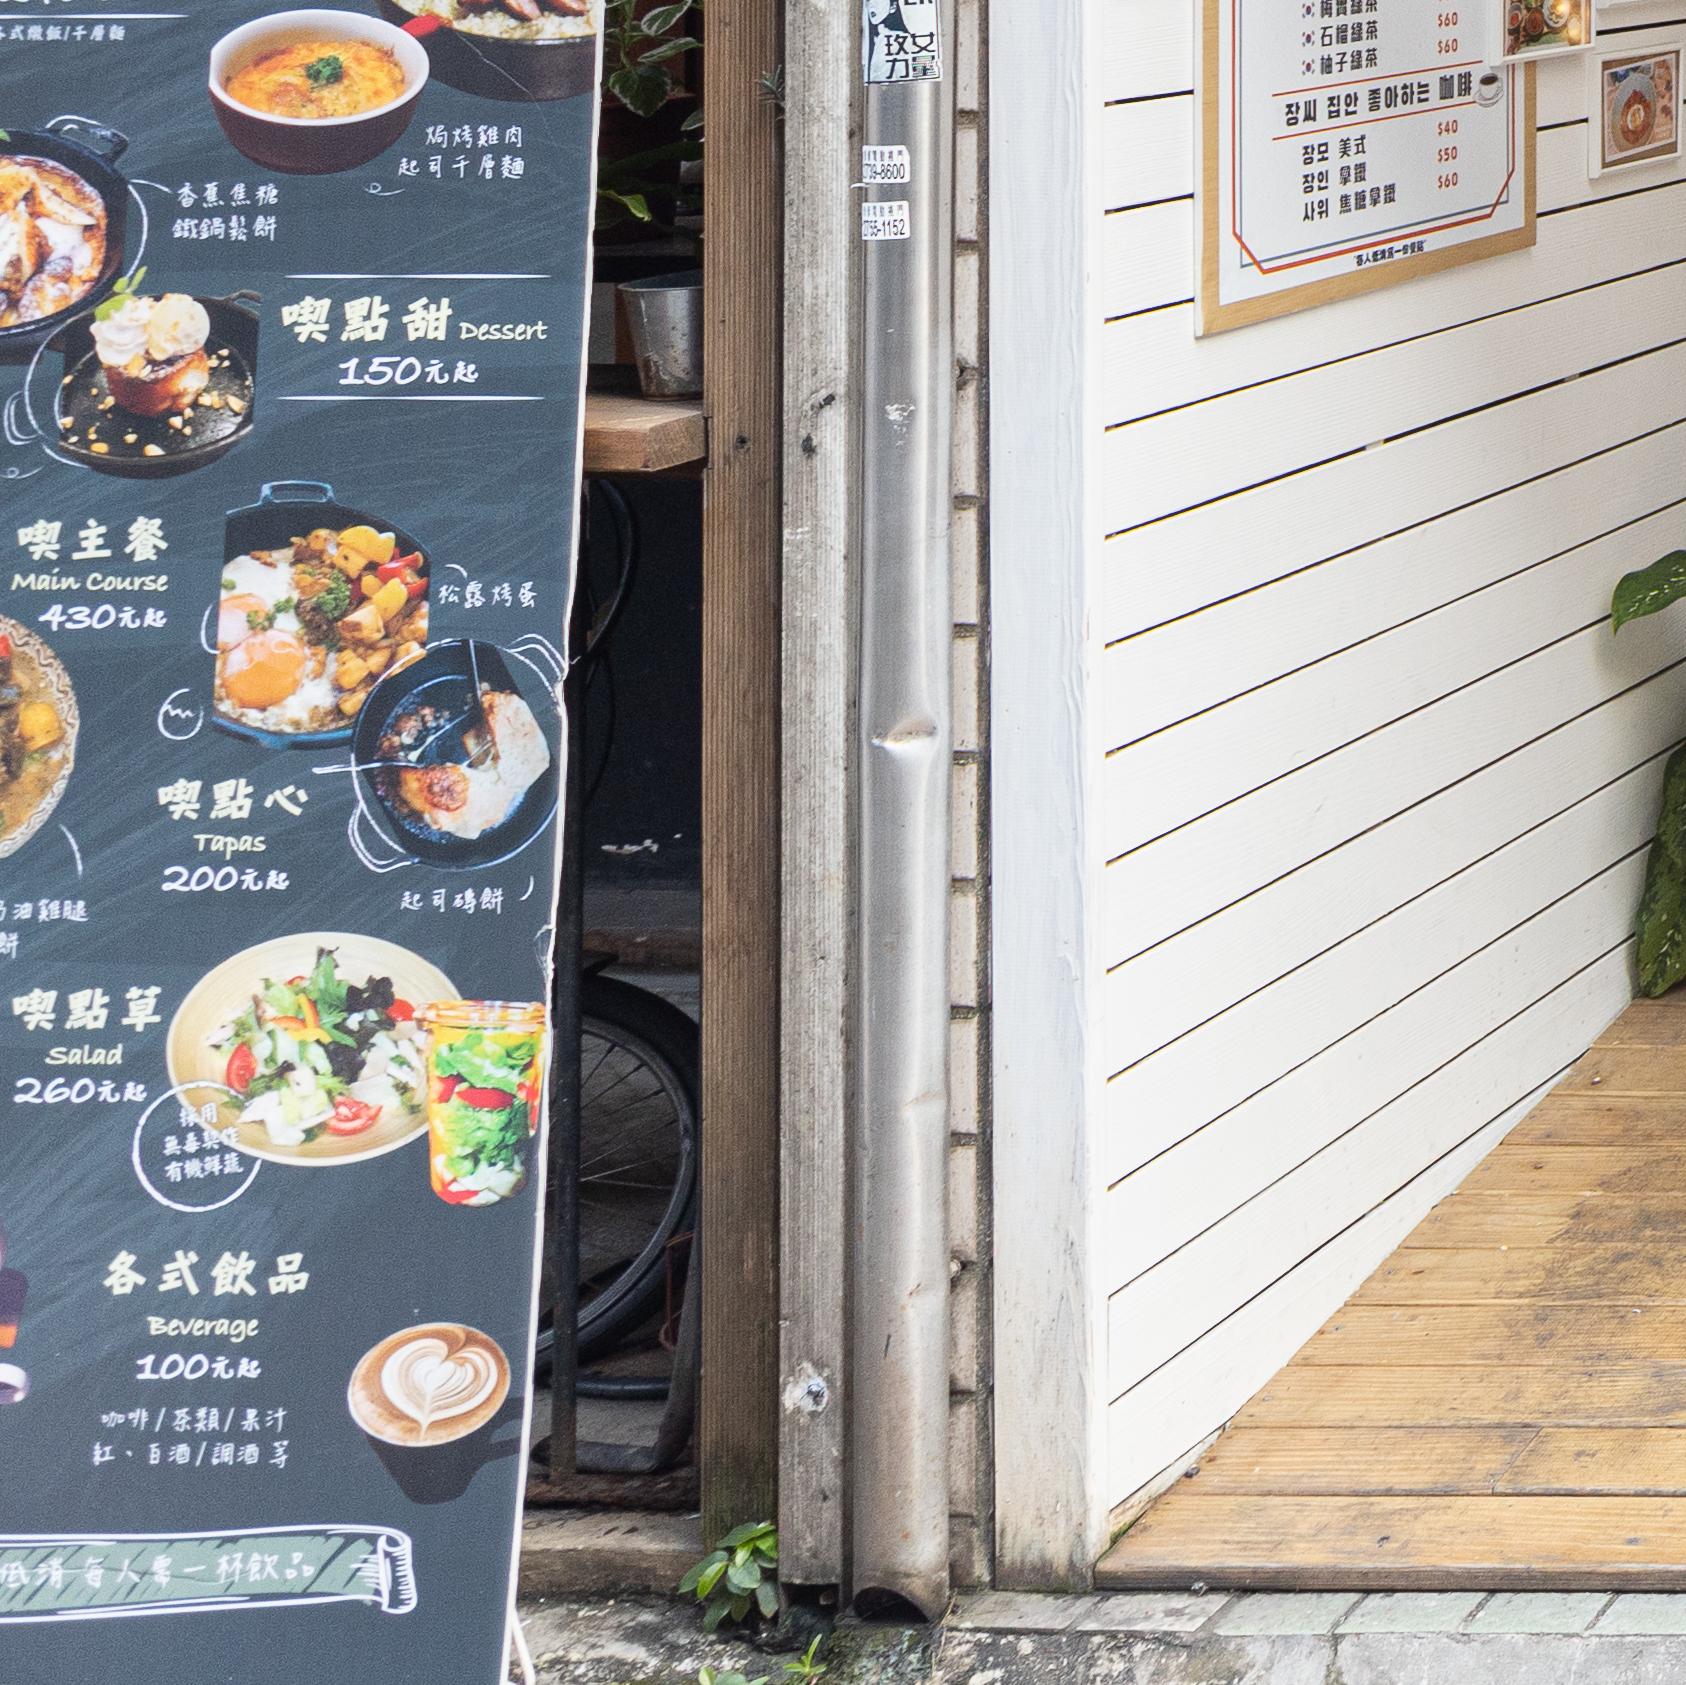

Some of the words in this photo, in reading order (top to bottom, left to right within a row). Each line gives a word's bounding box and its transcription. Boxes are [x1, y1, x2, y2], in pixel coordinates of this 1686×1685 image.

[1437, 12, 1458, 27] $60
[1437, 39, 1458, 54] $60
[1286, 99, 1317, 126] 장씨
[1328, 92, 1358, 119] 집안
[1368, 81, 1429, 112] 좋아하는
[425, 125, 523, 148] 焗烤雞肉
[1303, 142, 1329, 165] 장모
[1339, 134, 1366, 159] 美式
[1437, 120, 1458, 136] $40
[398, 155, 525, 179] 起司千層麵
[1303, 170, 1329, 194] 장인
[1437, 146, 1458, 163] $50
[177, 182, 279, 208] 香蕉焦糖
[1303, 198, 1329, 222] 사위
[1437, 172, 1458, 189] $60
[172, 215, 277, 241] 鐵鍋鬆餅
[281, 295, 452, 343] 喫點甜
[459, 321, 548, 341] Dessert
[338, 357, 479, 385] 150元起
[17, 516, 169, 562] 喫主餐
[11, 568, 80, 592] Main
[86, 571, 168, 592] Course
[437, 581, 537, 608] 松露烤蛋
[38, 604, 167, 630] 430元起
[158, 778, 308, 818] 喫點心
[194, 833, 266, 863] Tapas
[162, 866, 289, 891] 200元起
[12, 986, 162, 1032] 喫點草
[14, 1078, 147, 1103] 260元起
[180, 1103, 217, 1127] 採用
[104, 1250, 310, 1296] 各式飲品
[148, 1316, 258, 1342] Beverage
[136, 1353, 261, 1380] 100元起
